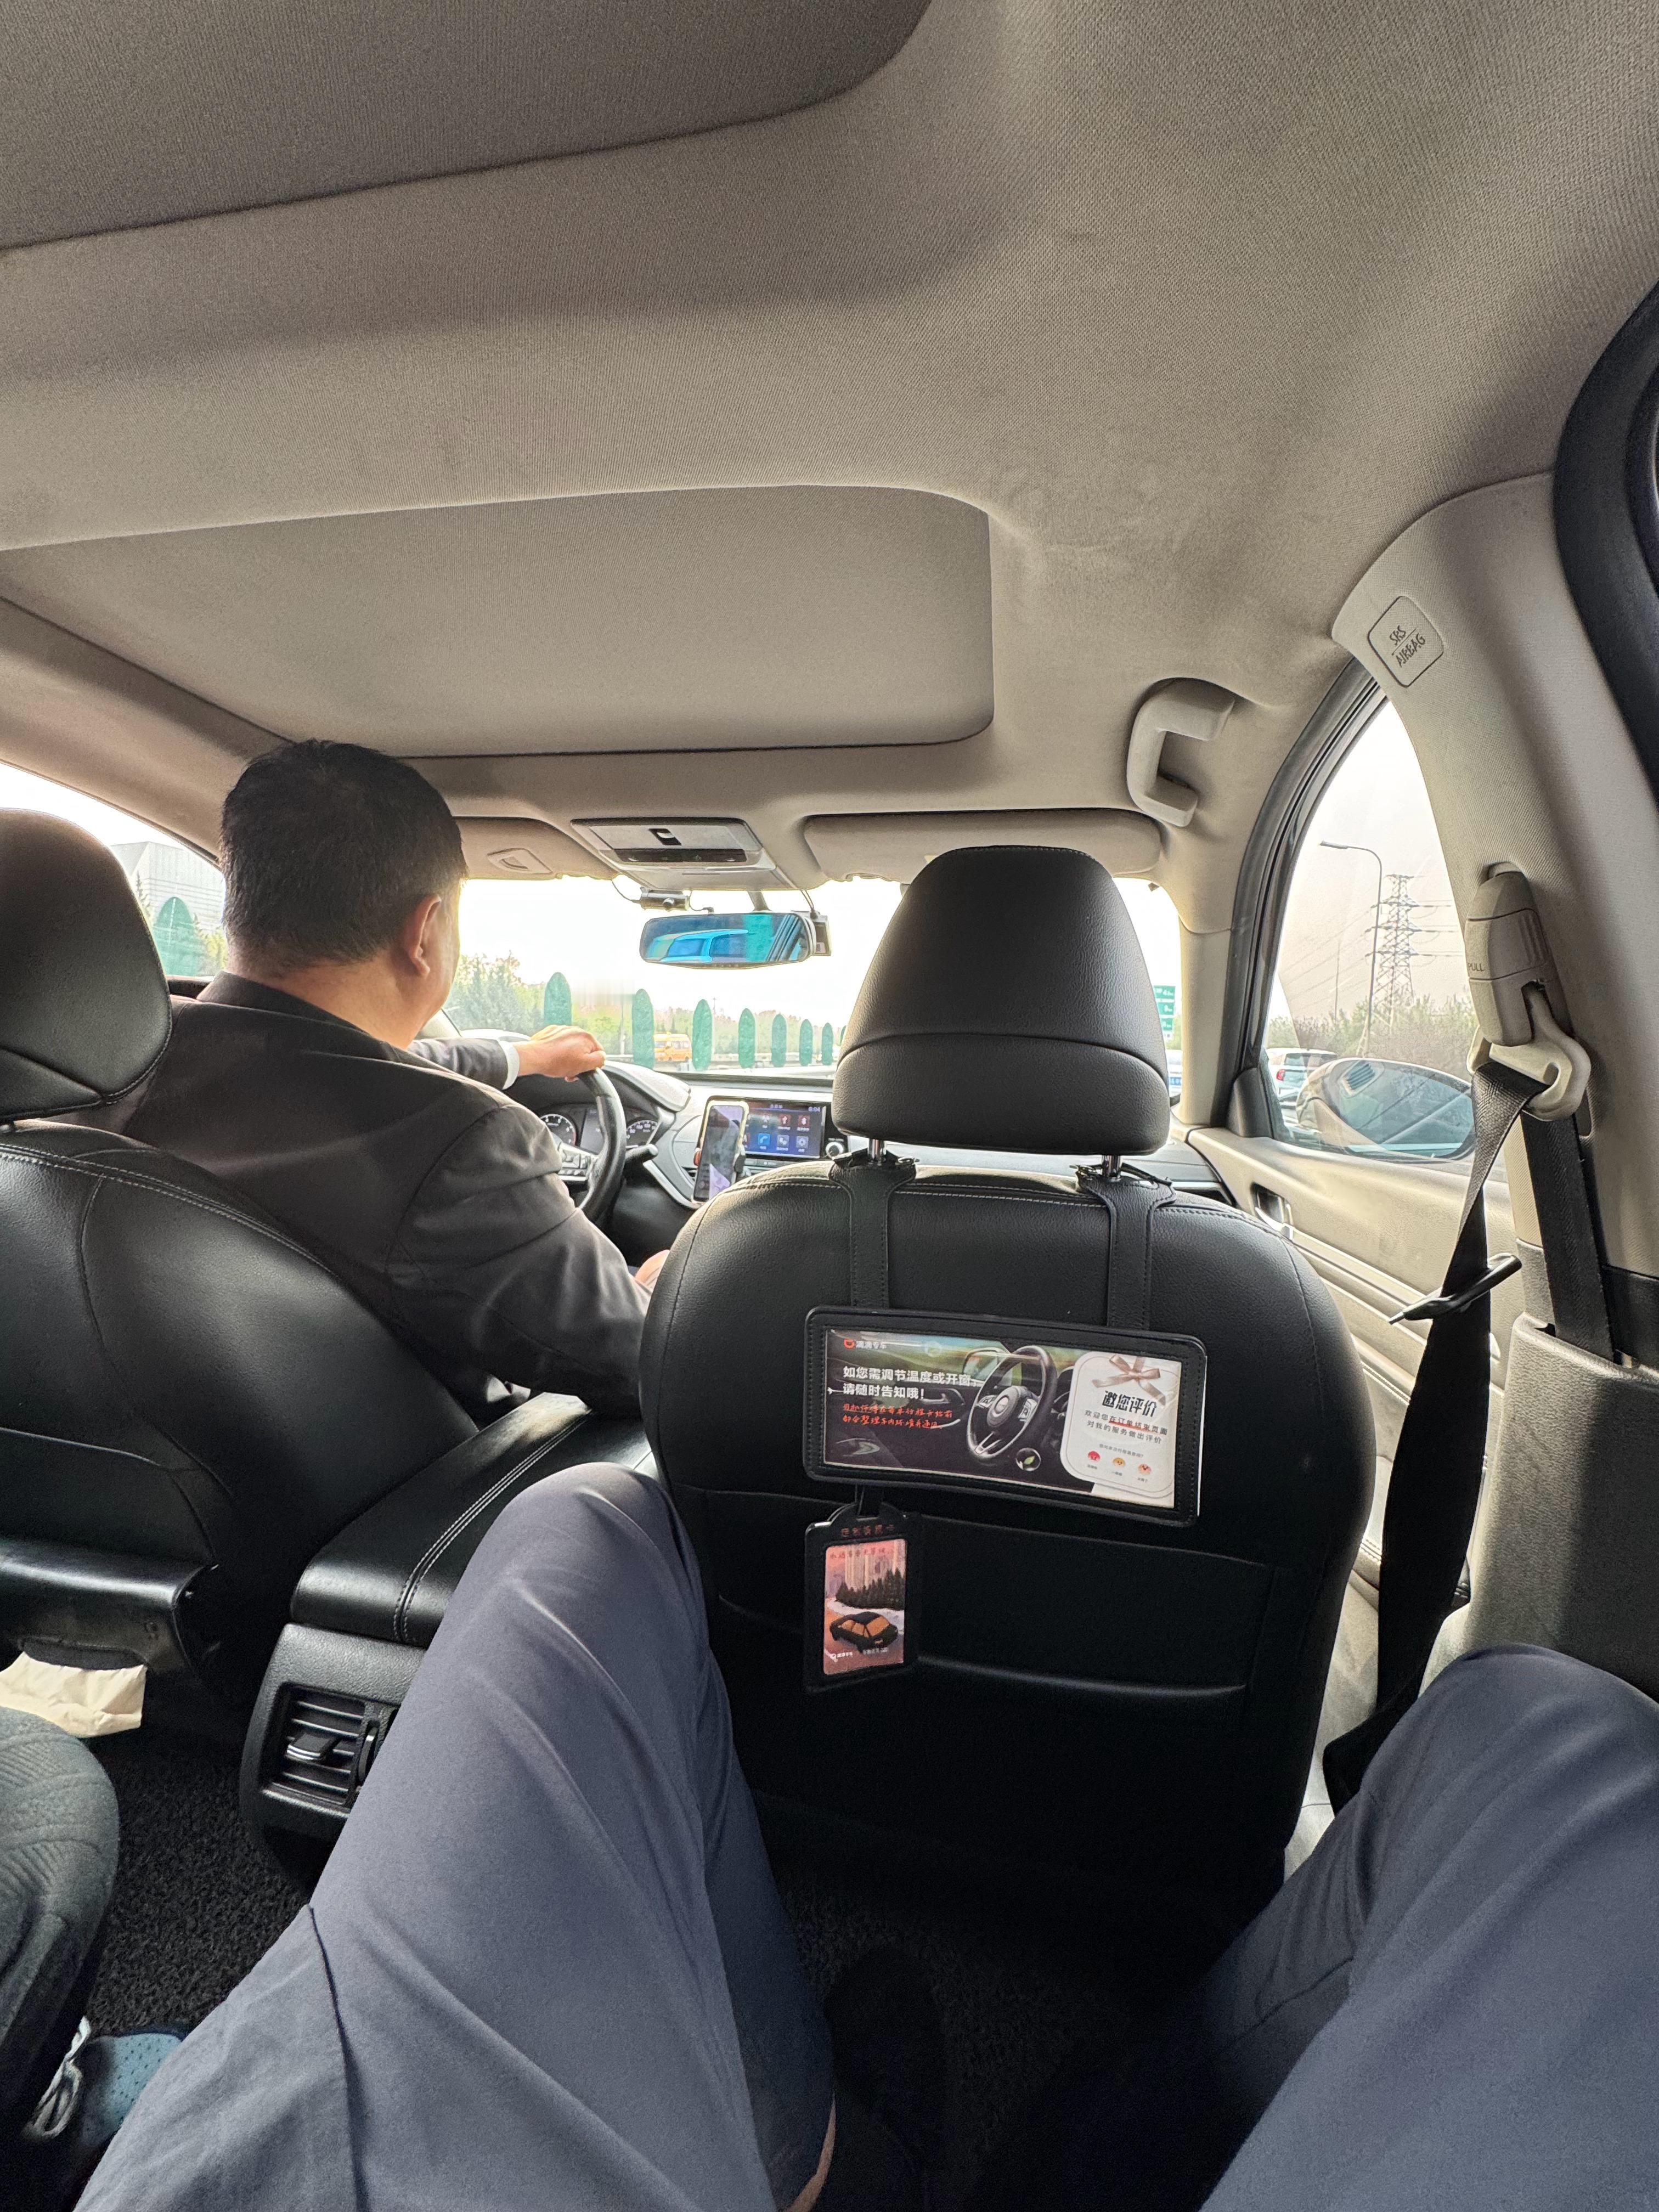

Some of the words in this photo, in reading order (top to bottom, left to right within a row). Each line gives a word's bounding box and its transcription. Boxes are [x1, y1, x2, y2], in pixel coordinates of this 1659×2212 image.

[1389, 625, 1406, 646] SRS
[1395, 633, 1426, 668] AIRBAG
[1468, 963, 1484, 972] PULL
[1102, 1390, 1157, 1417] 邀您评价
[1084, 1409, 1167, 1435] 欢迎您在订单结束页面
[1087, 1420, 1161, 1444] 对我的服务做出评价
